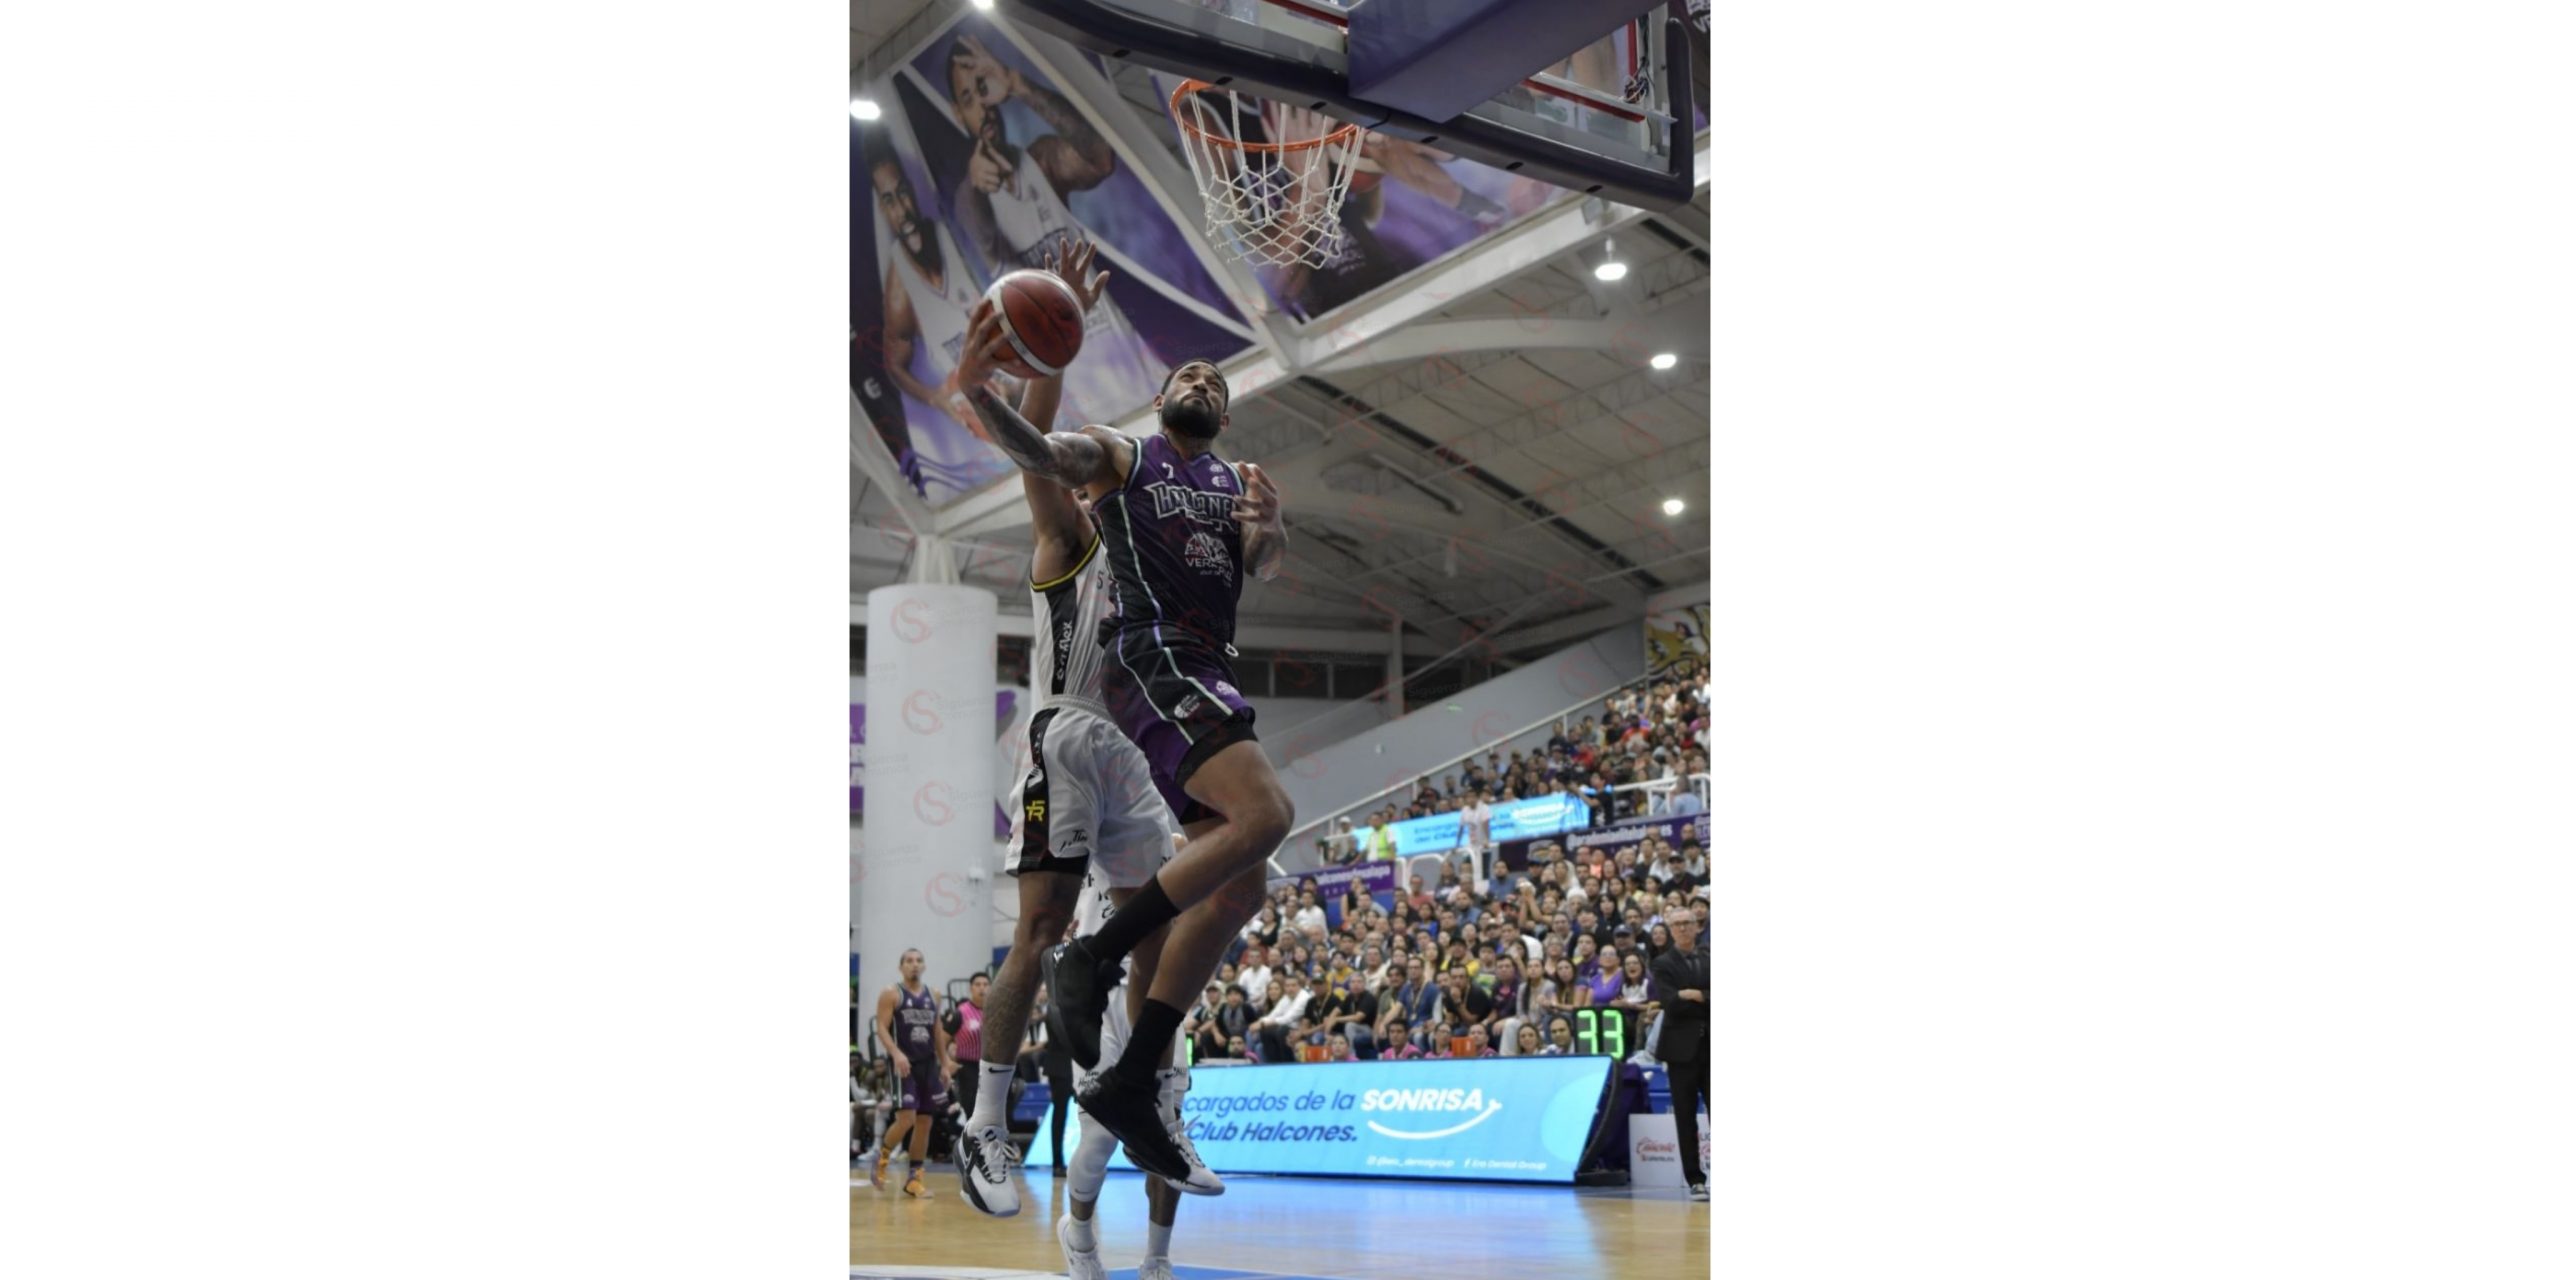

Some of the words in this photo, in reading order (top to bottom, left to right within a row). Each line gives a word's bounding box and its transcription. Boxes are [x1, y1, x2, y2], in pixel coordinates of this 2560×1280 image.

[1184, 1091, 1287, 1118] cargados
[1294, 1090, 1325, 1111] de
[1331, 1089, 1355, 1110] la
[1360, 1087, 1483, 1112] SONRISA
[1187, 1120, 1238, 1142] Club
[1240, 1121, 1358, 1143] Halcones.
